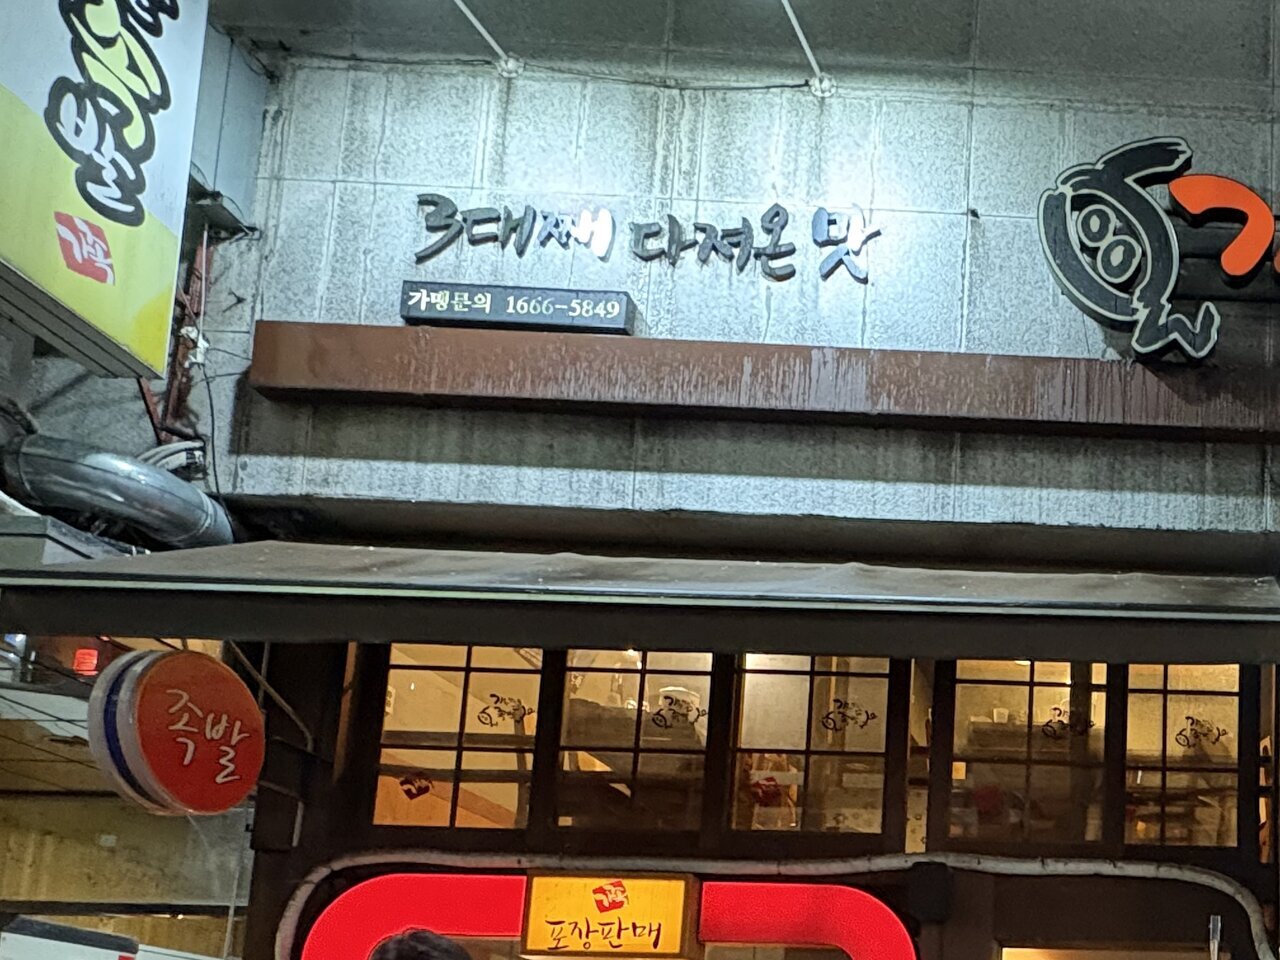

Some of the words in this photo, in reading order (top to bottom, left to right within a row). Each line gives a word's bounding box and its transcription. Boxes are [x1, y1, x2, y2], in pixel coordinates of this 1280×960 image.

[414, 193, 616, 264] 3대째
[629, 203, 796, 283] 다져온
[812, 203, 882, 285] 맛
[407, 288, 493, 315] 가맹문의
[505, 294, 620, 319] 1666-5849
[165, 688, 251, 785] 족발
[544, 918, 662, 952] 포장판매
